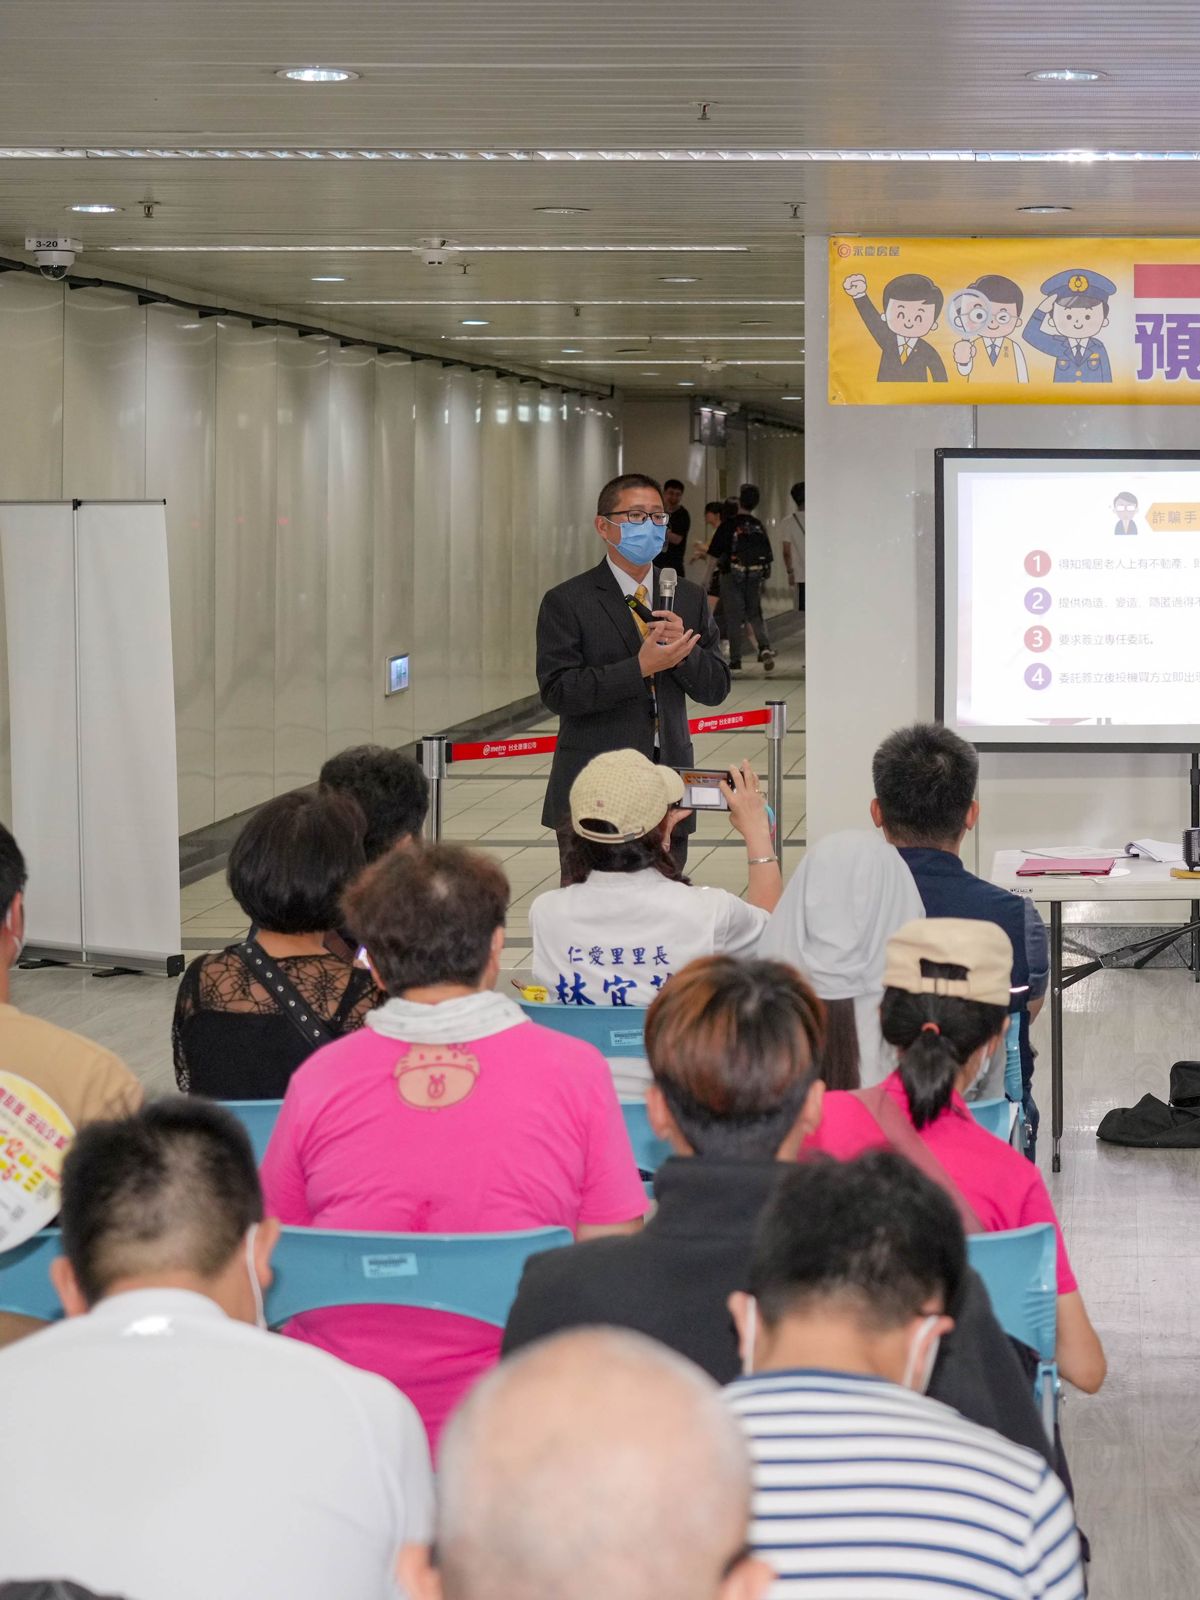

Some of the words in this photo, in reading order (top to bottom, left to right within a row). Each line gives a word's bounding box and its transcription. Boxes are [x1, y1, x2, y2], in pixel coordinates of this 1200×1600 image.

[853, 246, 900, 257] 永慶房屋
[1033, 555, 1041, 572] 1
[1032, 592, 1044, 609] 2
[1032, 630, 1043, 647] 3
[1031, 668, 1044, 685] 4
[568, 945, 670, 966] 仁愛里里長
